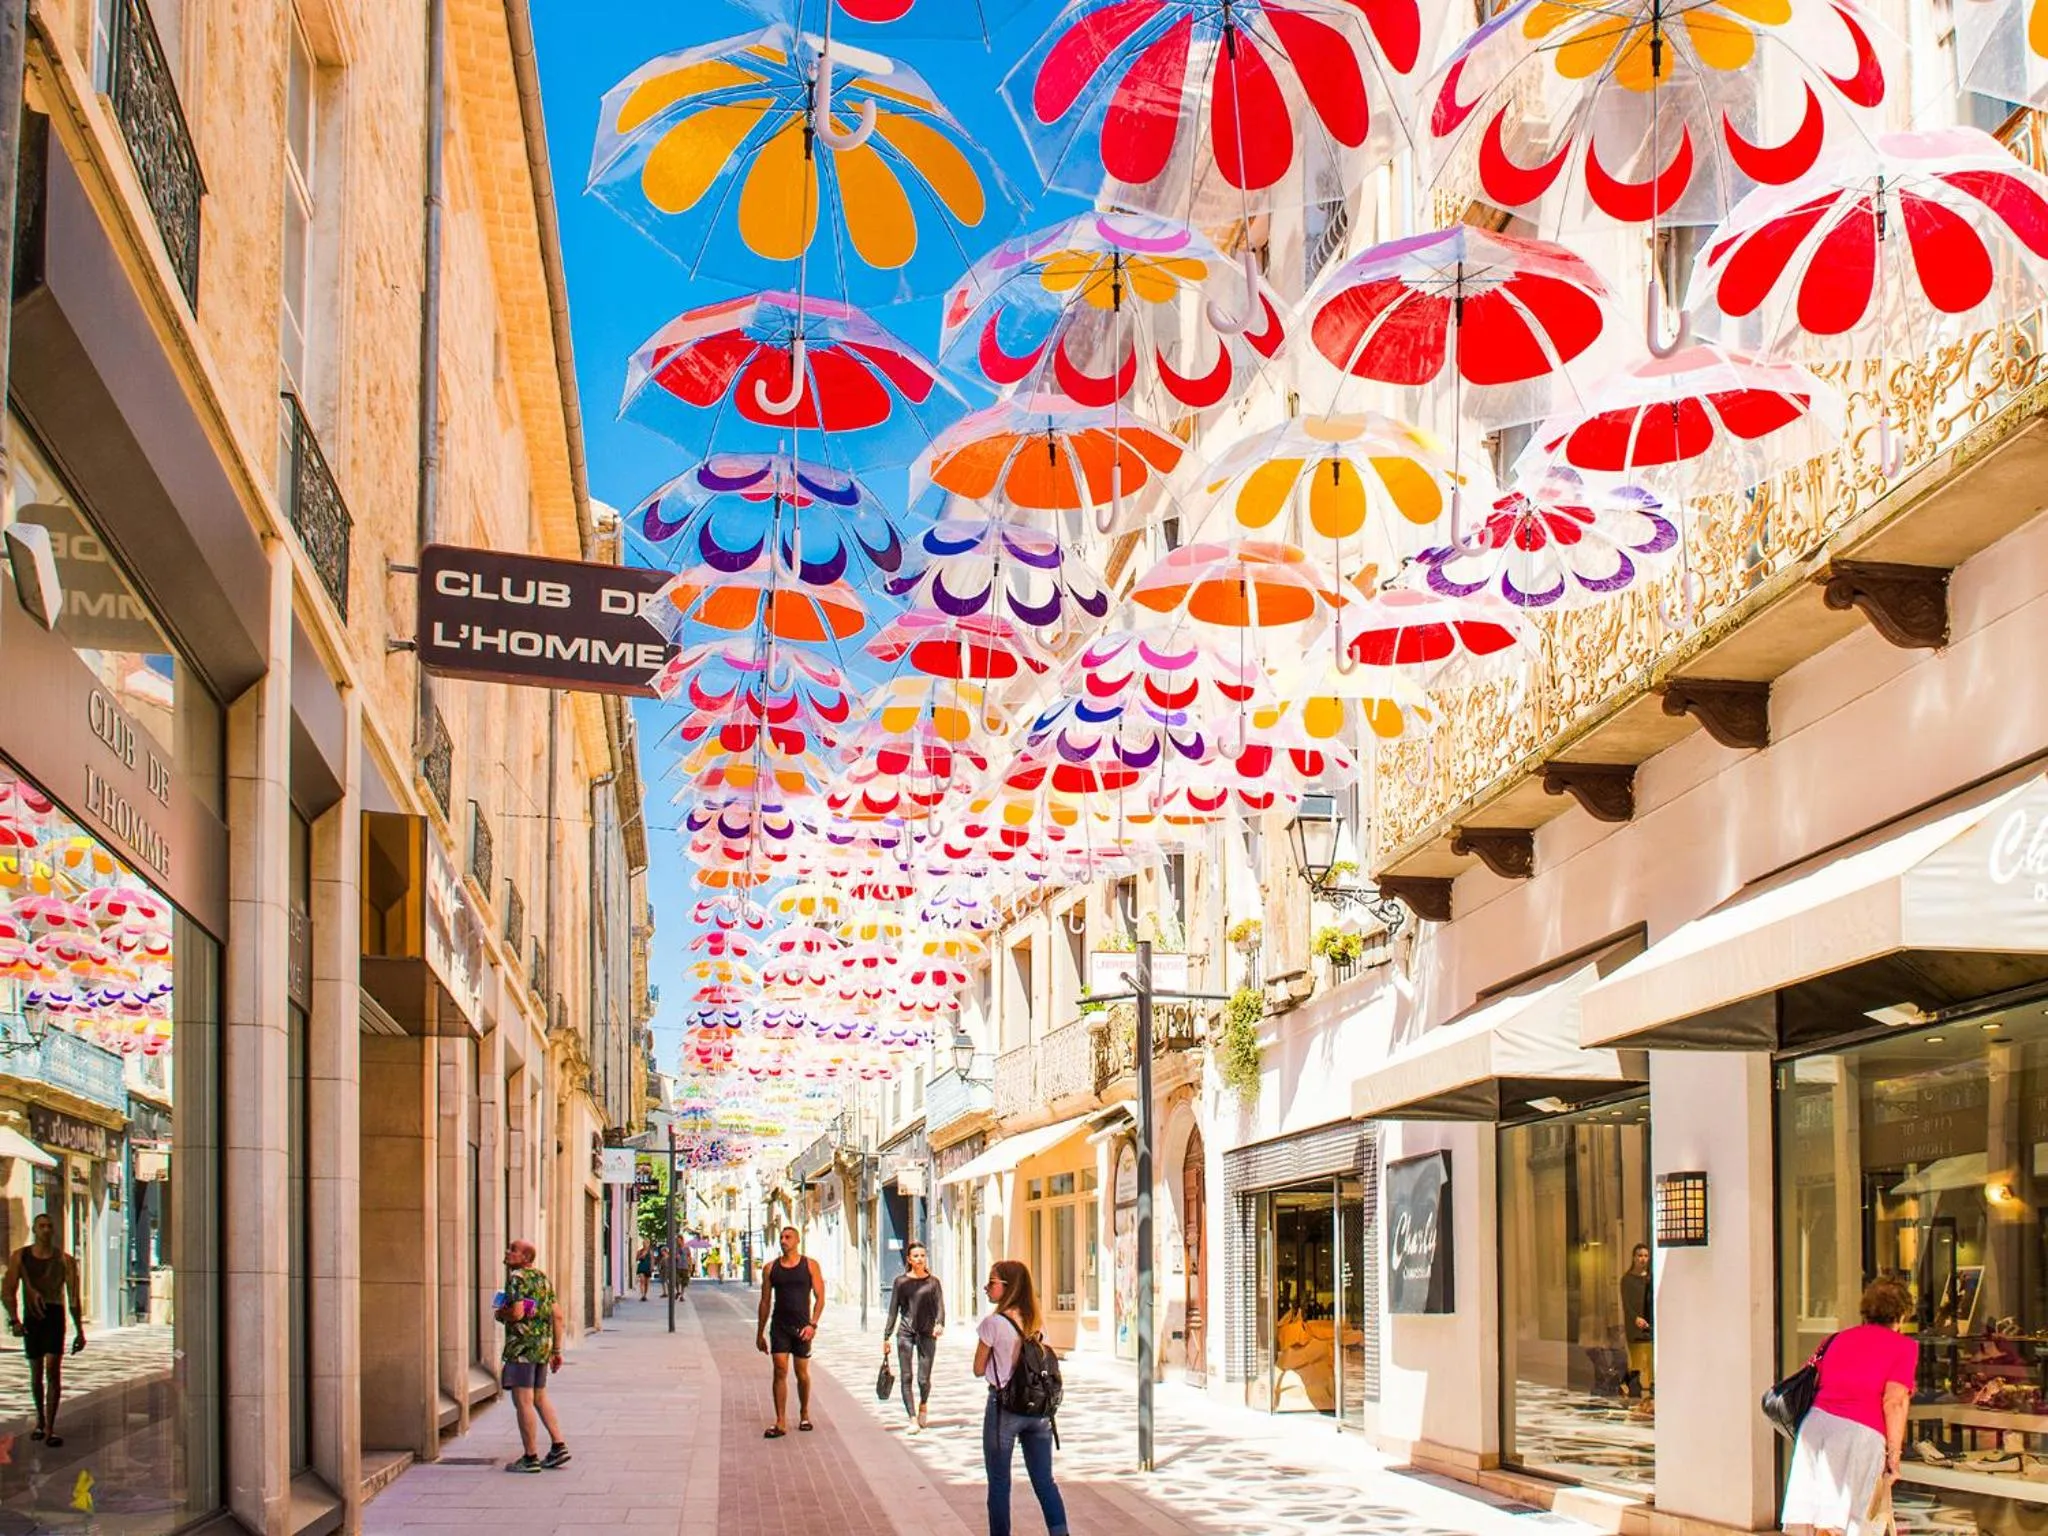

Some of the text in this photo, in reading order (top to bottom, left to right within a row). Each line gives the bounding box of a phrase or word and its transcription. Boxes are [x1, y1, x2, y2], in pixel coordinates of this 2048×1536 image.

[435, 570, 571, 609] CLUB
[433, 622, 666, 669] L'HOMME
[88, 688, 171, 808] CLUB DE
[85, 763, 171, 881] L'HOMME
